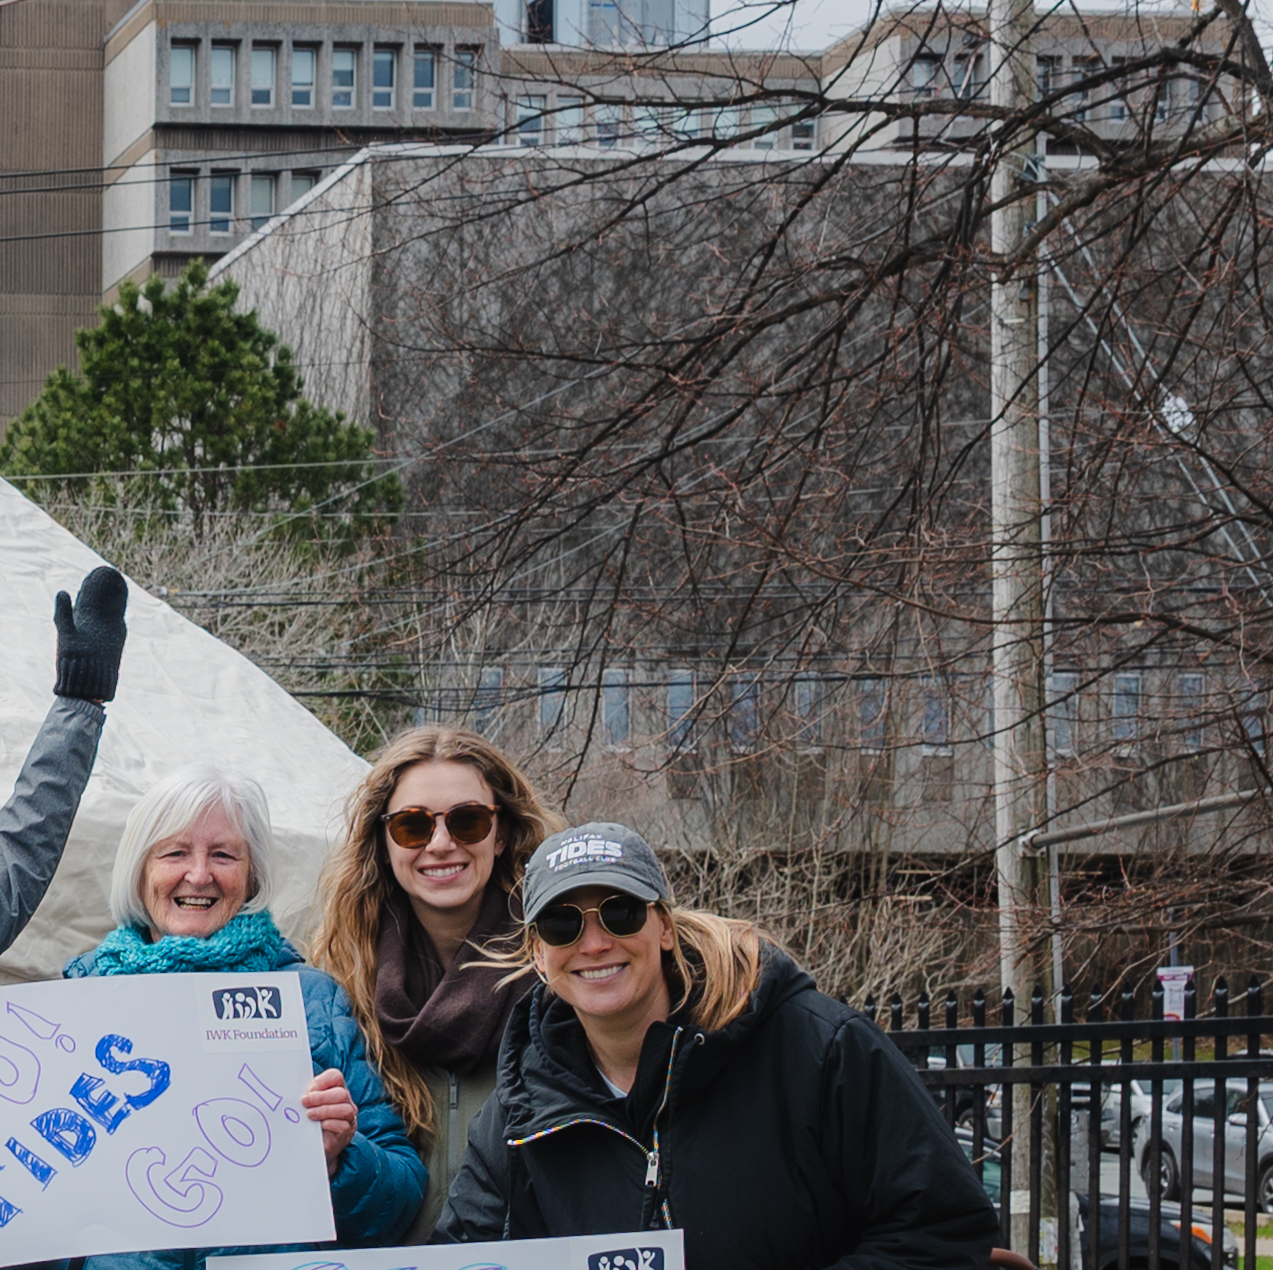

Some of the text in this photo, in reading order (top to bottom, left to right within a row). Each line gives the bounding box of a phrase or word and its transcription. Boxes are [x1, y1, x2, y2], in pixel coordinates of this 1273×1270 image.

[546, 839, 623, 869] TIDES
[206, 1027, 298, 1040] IWK Foundation
[125, 1062, 300, 1228] GO!
